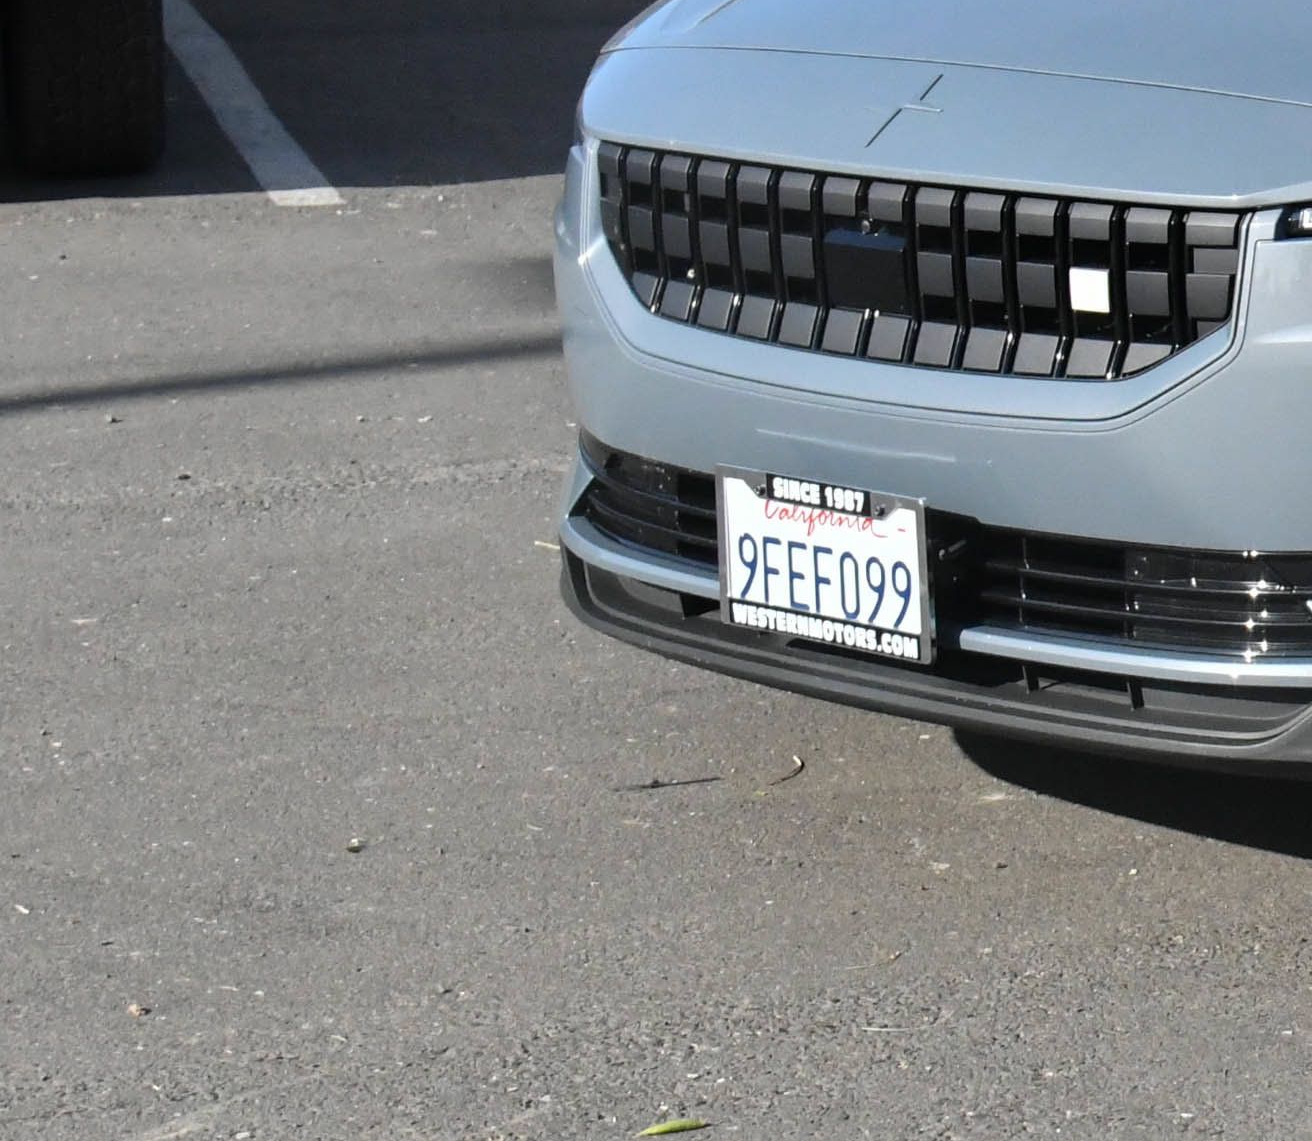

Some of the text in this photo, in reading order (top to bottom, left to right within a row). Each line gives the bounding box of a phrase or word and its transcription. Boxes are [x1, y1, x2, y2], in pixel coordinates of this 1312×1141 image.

[773, 477, 820, 505] SINCE
[764, 499, 888, 537] California
[738, 533, 912, 629] 9FEF099
[732, 602, 919, 659] WESTERNMOTORS.COM
